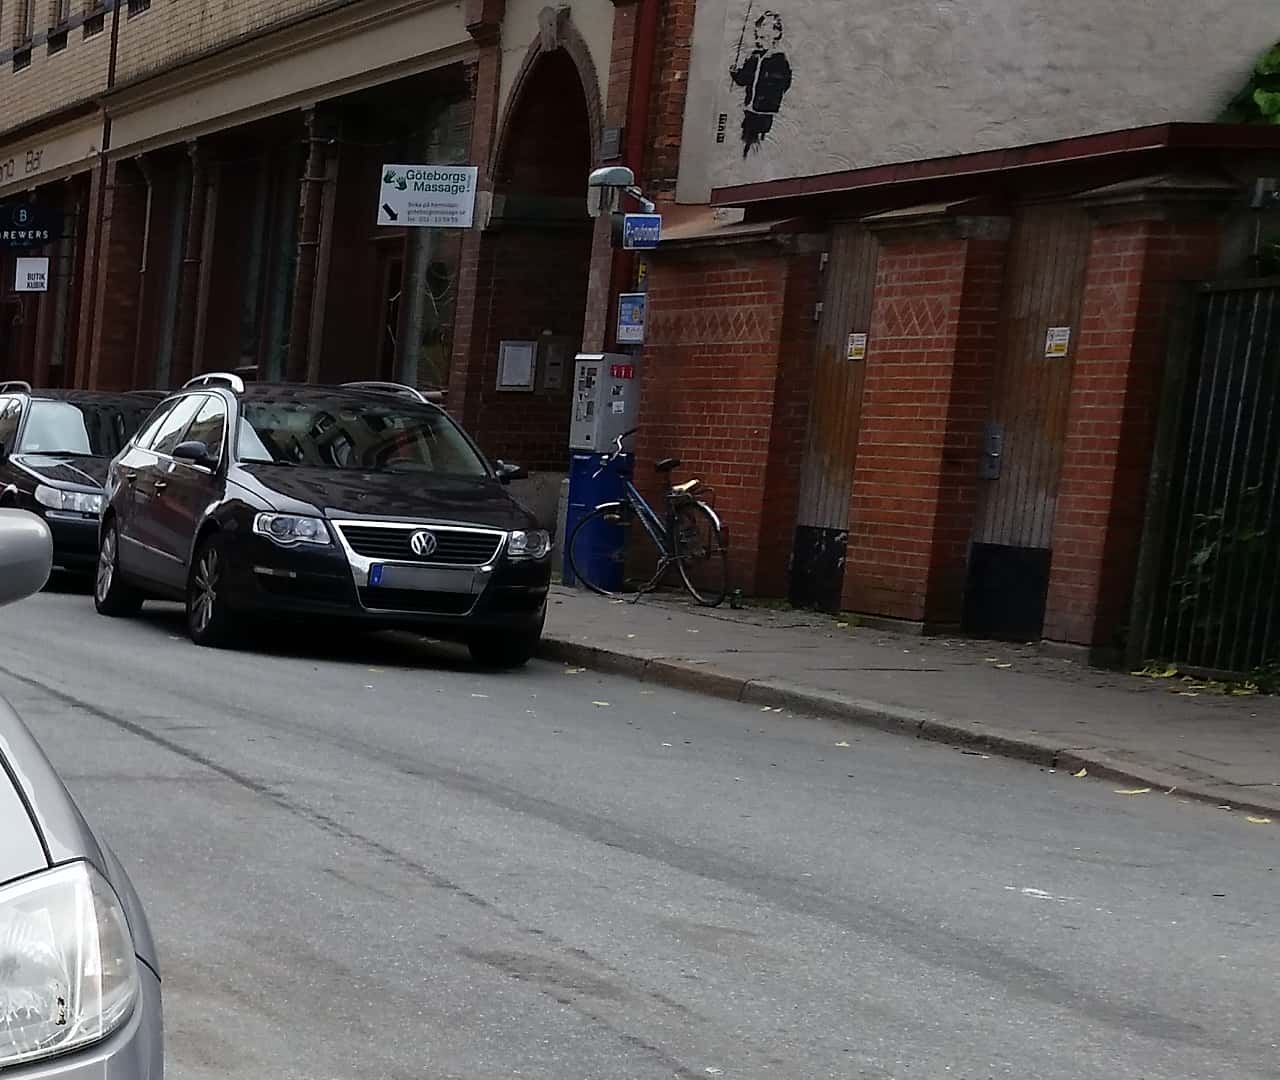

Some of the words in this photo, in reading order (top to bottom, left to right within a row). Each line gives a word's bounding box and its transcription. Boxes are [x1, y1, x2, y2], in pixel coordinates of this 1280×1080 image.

[25, 150, 43, 173] Bar
[406, 168, 466, 184] Göteborgs
[27, 272, 46, 281] BUTIK
